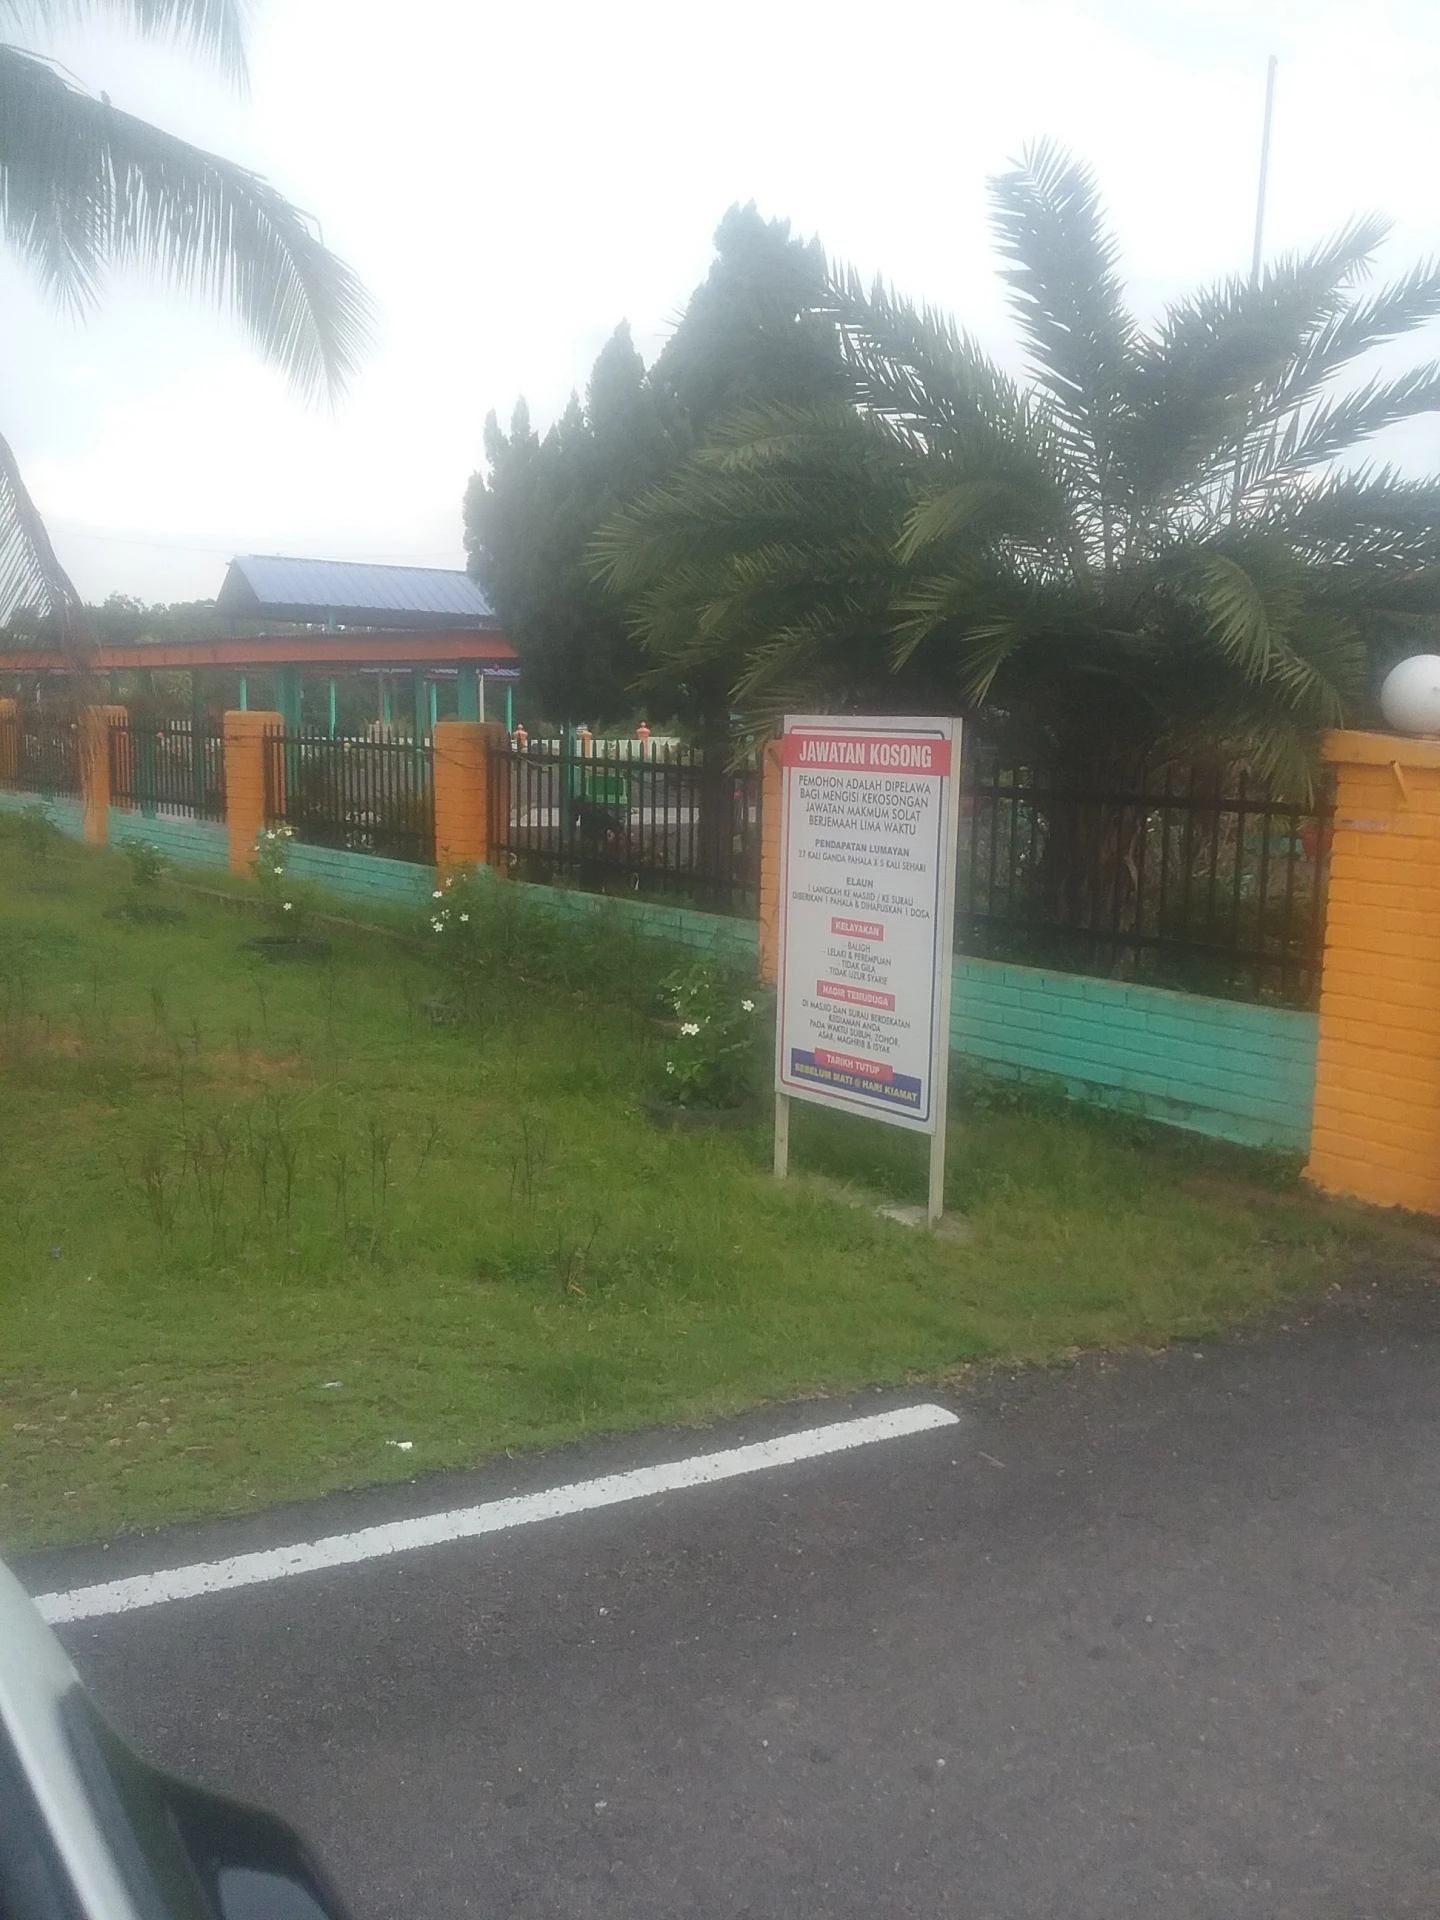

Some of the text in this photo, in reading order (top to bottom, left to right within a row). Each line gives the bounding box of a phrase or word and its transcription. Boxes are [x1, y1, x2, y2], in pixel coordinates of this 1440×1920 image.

[799, 741, 931, 768] JAWATAN KOSONG
[799, 775, 931, 794] PEMOHON ADALAH DIPELAWA
[800, 788, 928, 808] BAGI MENGISI KEKOSONGAN
[806, 802, 921, 821] JAWATAN MAKMUM SOLAT
[809, 815, 916, 835] BERJEMAAH LIMA WAKTU
[815, 839, 909, 856] PENDAPATAN LUMAYAN
[799, 849, 806, 858] 27
[808, 851, 820, 859] KALI
[823, 852, 846, 863] GANDA
[848, 857, 872, 866] PAHALA
[886, 860, 900, 869] KALI
[903, 862, 926, 872] SEHARI
[846, 877, 873, 888] ELAUN
[793, 891, 822, 903] DIBERIKAN
[830, 897, 853, 908] PAHALA
[855, 900, 859, 908] &
[861, 900, 902, 915] DIHAPUSKAN
[911, 909, 930, 919] DOSA
[813, 885, 841, 895] LANGKAH
[844, 888, 851, 897] KE
[853, 890, 875, 901] MASJID
[882, 894, 891, 903] KE
[892, 895, 913, 906] SURAU
[835, 921, 880, 936] KELAYAKAN
[848, 941, 870, 953] BALIGH
[828, 948, 891, 966] LELAKI & PEREMPUAN
[842, 960, 876, 973] TIDAK GILA
[829, 967, 888, 985] TIDAK UZUR SYARIE
[823, 985, 888, 1006] HADIR TEMUDUGA
[802, 999, 910, 1029] DI MASJID DAN SURAU BERDEKATAN
[829, 1014, 881, 1032] KEDIAMAN ANDA
[810, 1019, 900, 1047] PADA WAKTU SUBUH, ZOHOR,
[837, 1036, 865, 1048] MAGHRIB
[873, 1044, 890, 1053] ISYAK
[827, 1055, 880, 1074] TARIKH TUTUP
[795, 1063, 831, 1080] SEBELUM
[833, 1073, 852, 1085] MATI
[862, 1080, 882, 1092] HARI
[885, 1085, 918, 1101] KIAMAT
